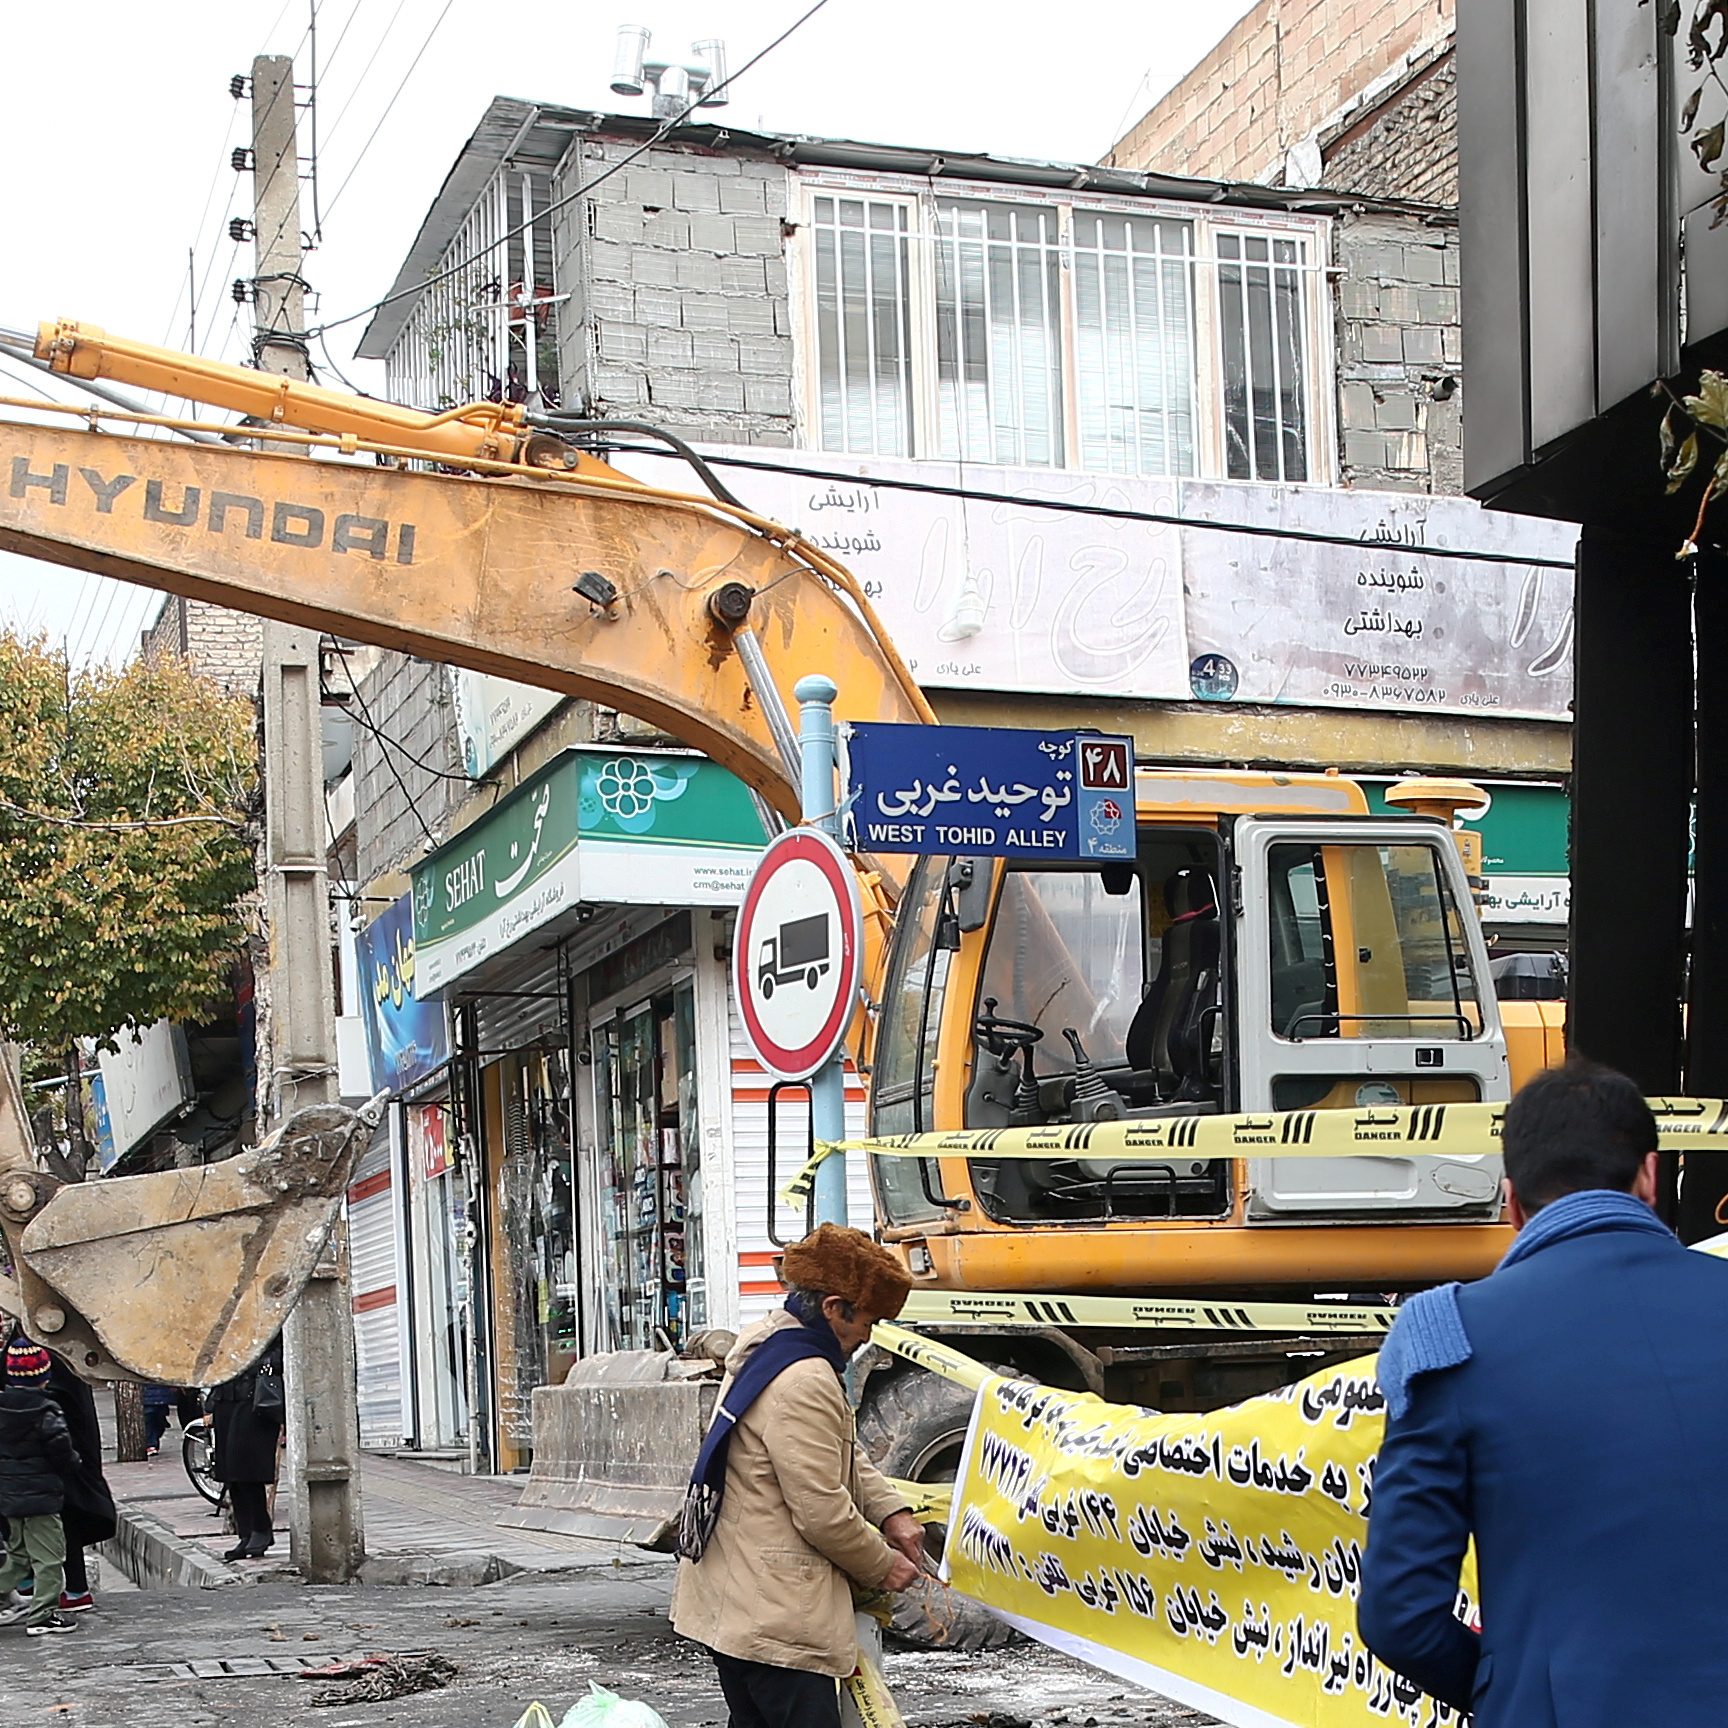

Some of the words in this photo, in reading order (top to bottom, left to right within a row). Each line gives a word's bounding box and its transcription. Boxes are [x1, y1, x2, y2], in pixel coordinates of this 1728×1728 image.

[10, 457, 416, 565] HYUNDAI
[809, 484, 880, 513] آرایشی
[1357, 566, 1425, 594] شوینده
[1344, 610, 1424, 641] بهداشتی
[1344, 662, 1428, 681] ۷۷۳۴۹۵۲۲
[1037, 738, 1075, 761] کوچه
[1084, 746, 1122, 785] ۴۸
[876, 763, 963, 818] غربی
[967, 769, 1073, 822] توحید
[868, 823, 925, 844] WEST
[935, 825, 996, 847] TOHID
[1005, 828, 1067, 849] ALLEY
[444, 849, 486, 913] SEHAT
[1505, 891, 1560, 910] آرایشی
[1124, 1138, 1164, 1148] DANGER
[1233, 1134, 1277, 1144] DANGER
[1354, 1131, 1402, 1141] DANGER
[1656, 1123, 1702, 1134] ANGER
[1026, 1141, 1062, 1150] DANGER
[1123, 1430, 1223, 1480] اختصاصی
[1227, 1438, 1314, 1494] خدمات
[1321, 1462, 1352, 1513] به
[1080, 1487, 1119, 1542] ۱۴۴
[1128, 1505, 1191, 1561] خیابان
[1166, 1585, 1228, 1638] خیابان
